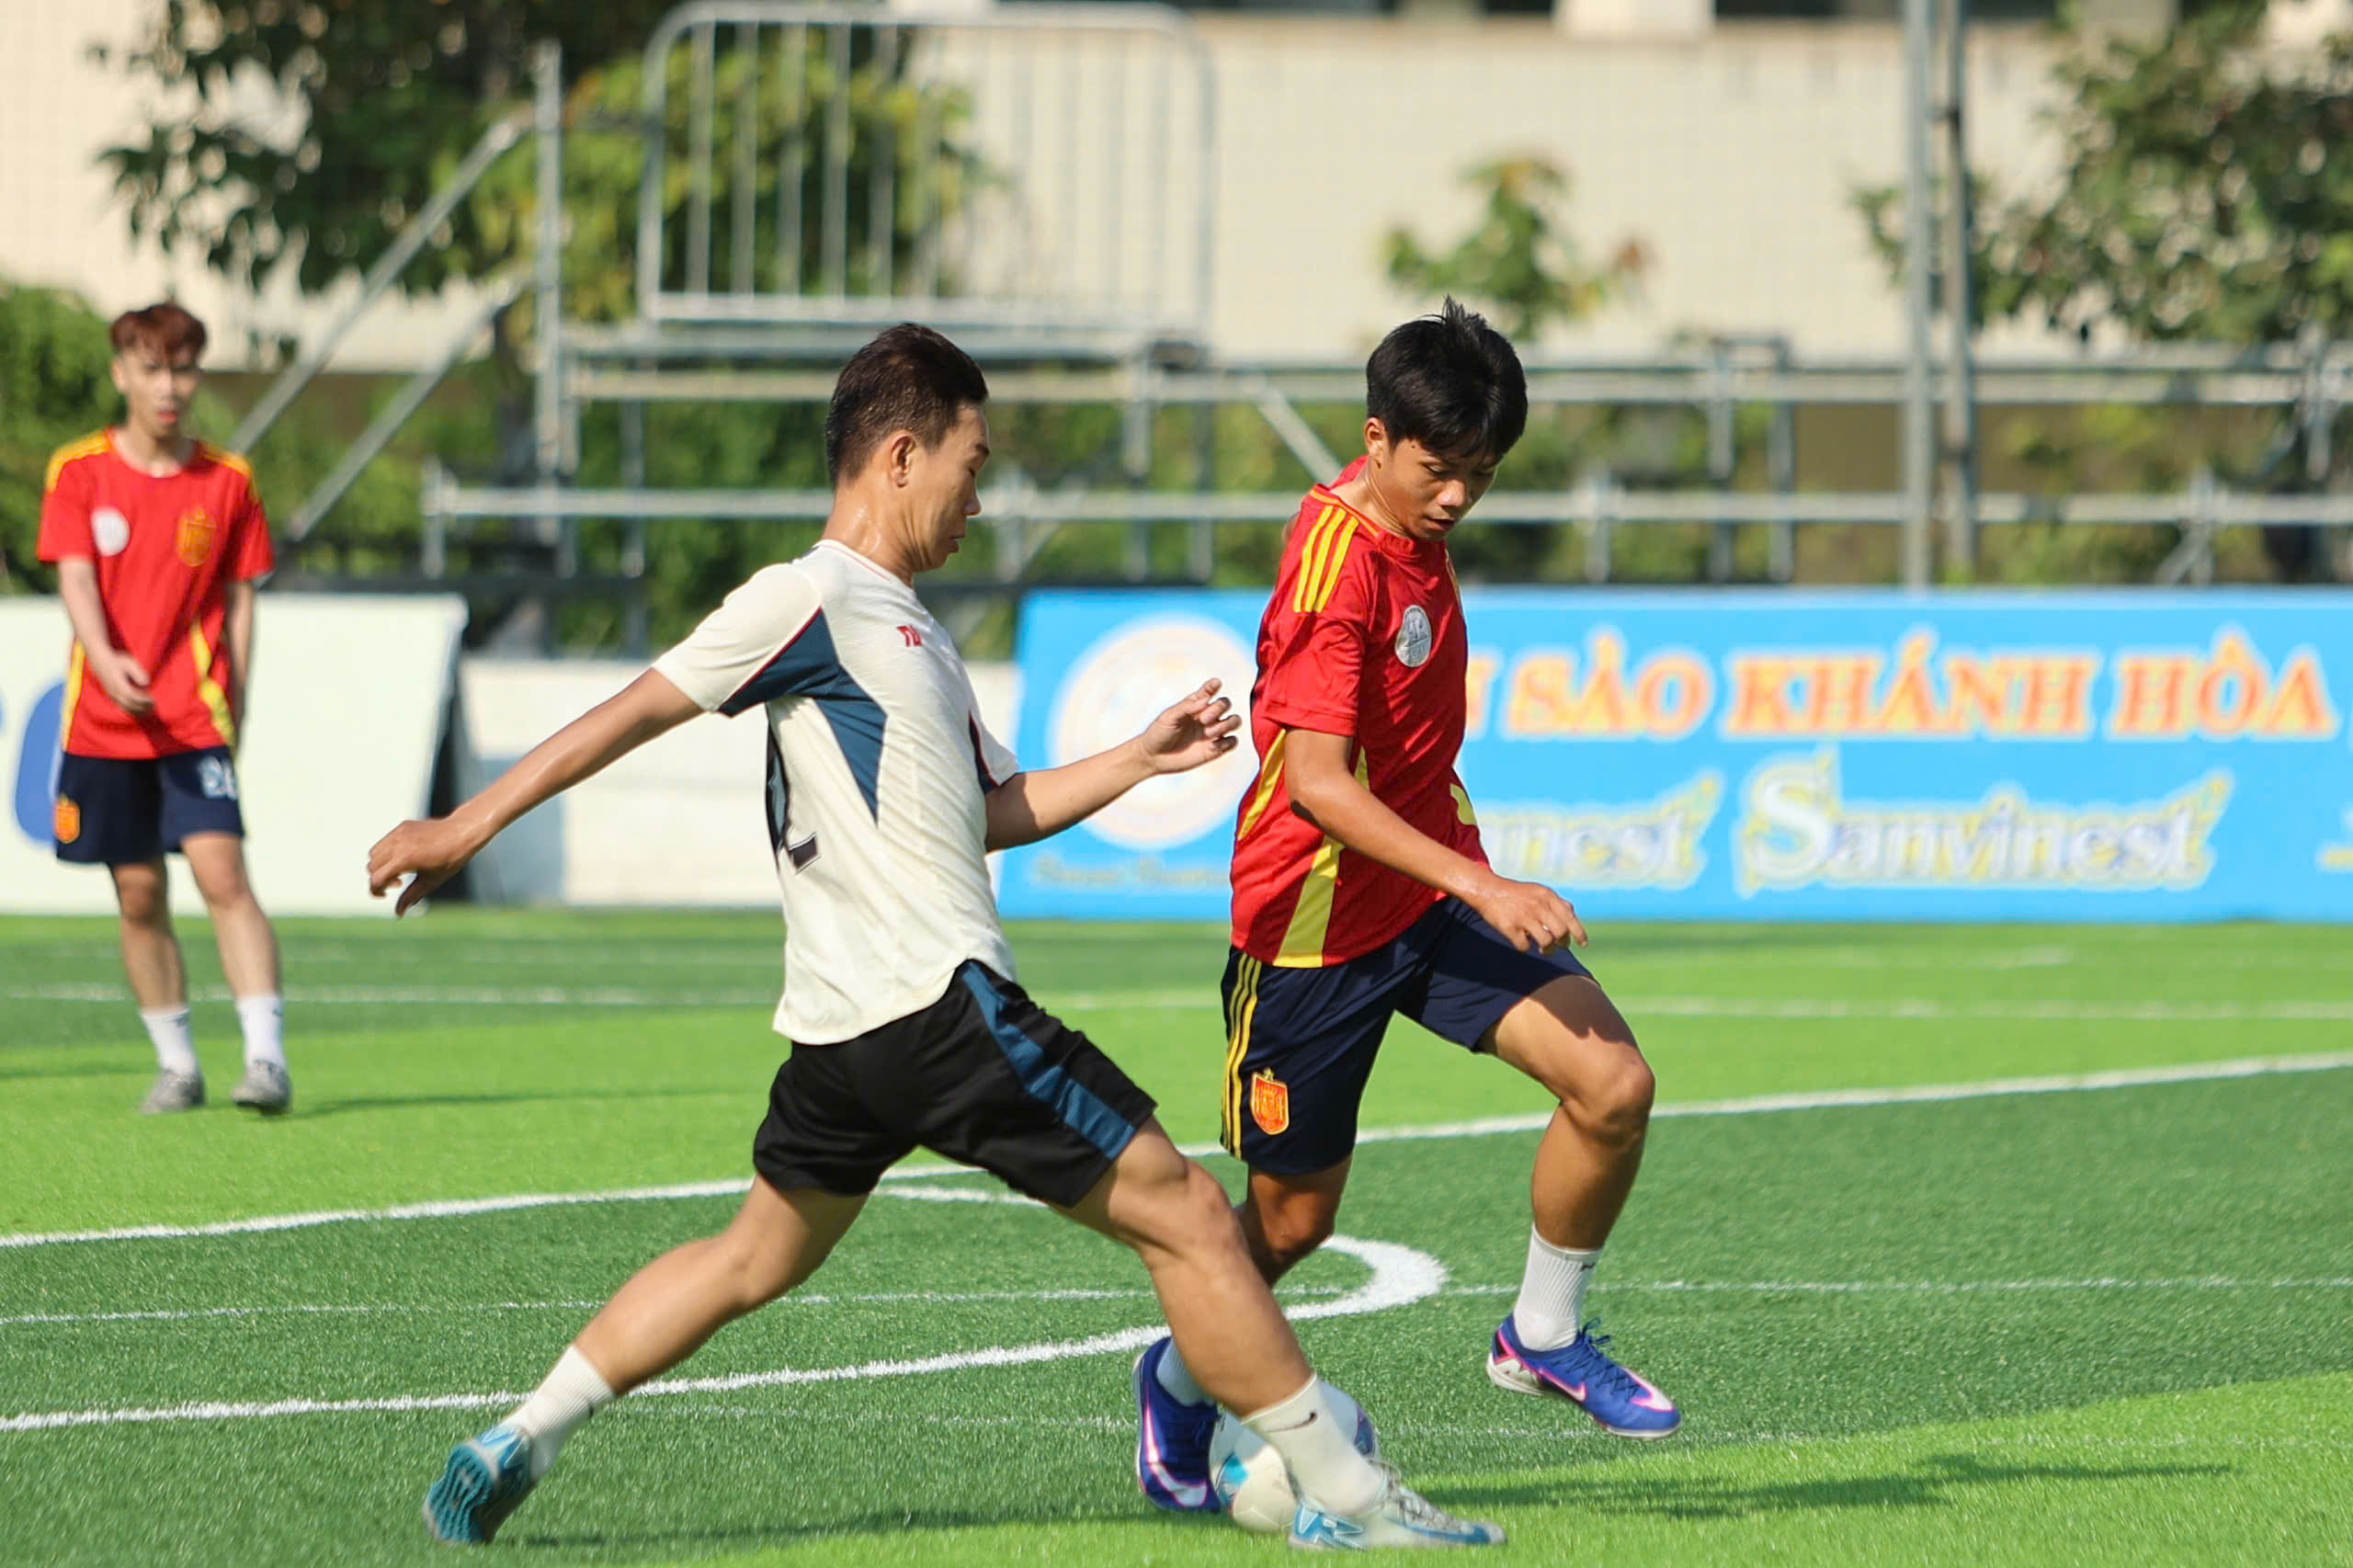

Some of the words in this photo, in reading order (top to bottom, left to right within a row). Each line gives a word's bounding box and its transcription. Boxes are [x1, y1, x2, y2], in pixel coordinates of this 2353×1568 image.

[1506, 631, 1713, 737] SẢO
[1724, 631, 2097, 737] KHÁNH
[1737, 748, 2226, 890] Sanvinest
